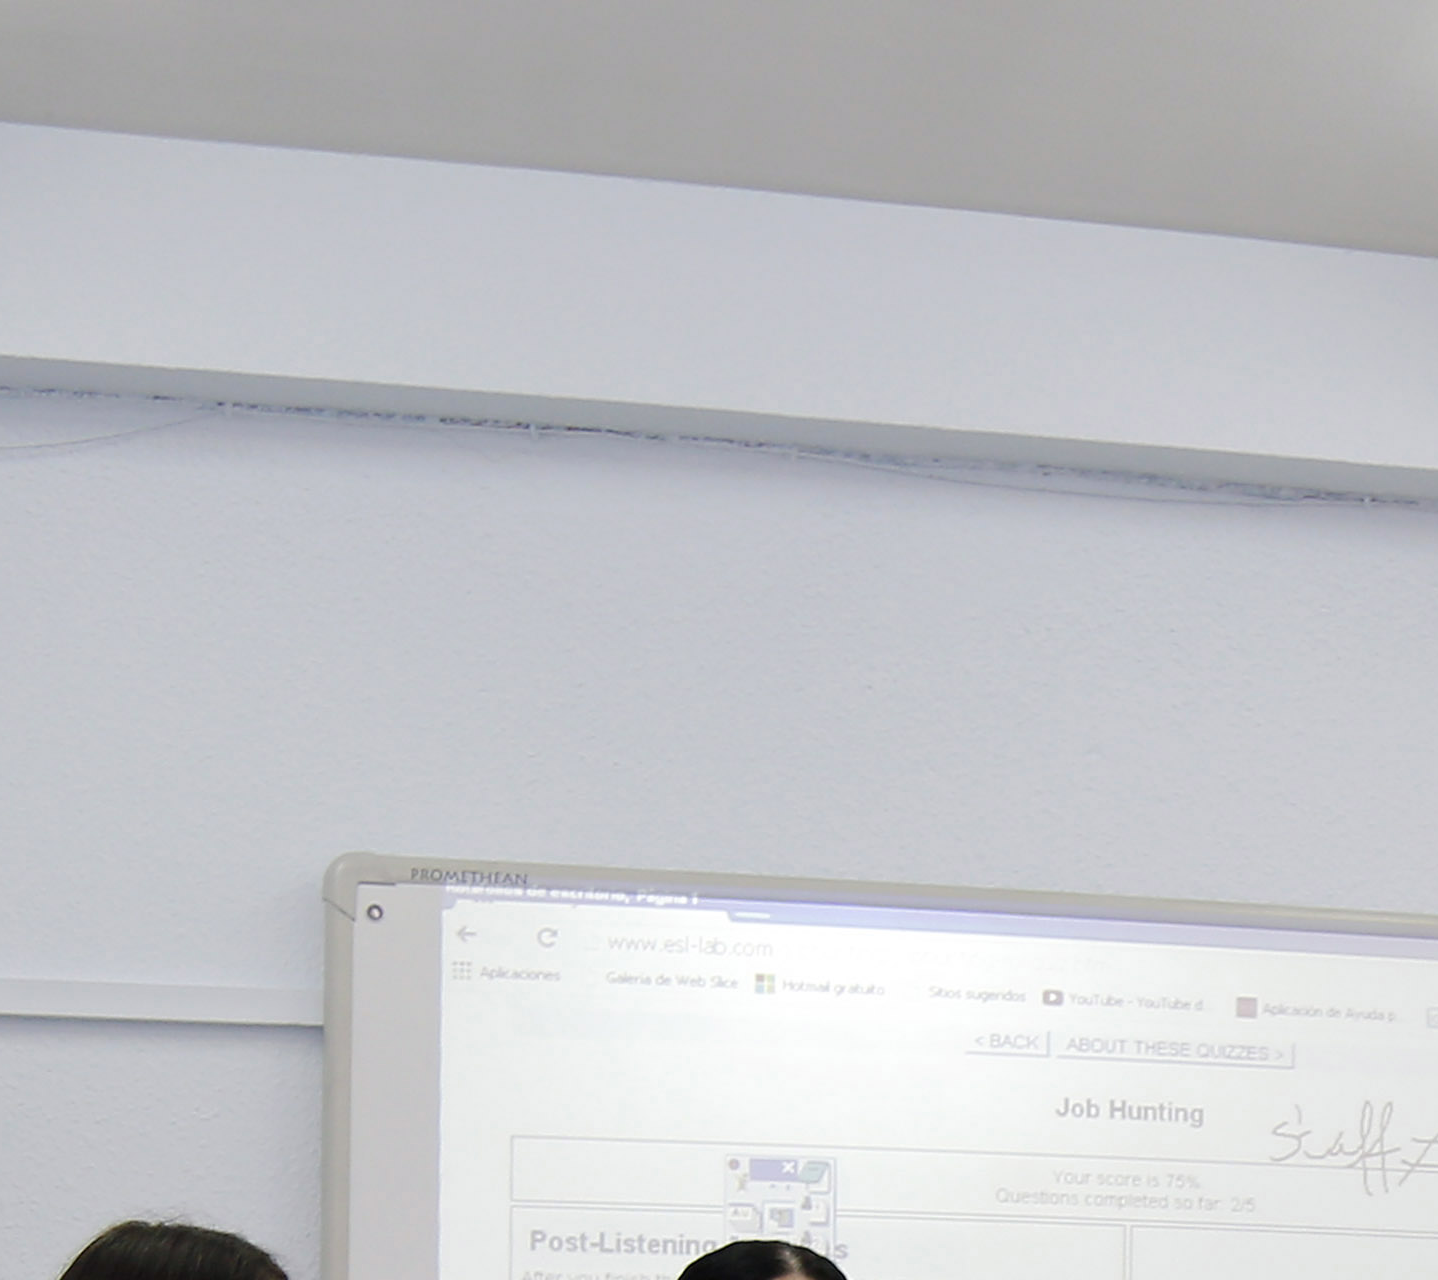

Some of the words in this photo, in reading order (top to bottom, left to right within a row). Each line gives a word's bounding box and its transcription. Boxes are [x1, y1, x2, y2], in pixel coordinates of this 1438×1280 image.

[411, 867, 529, 886] PROMETHEAN
[608, 933, 773, 957] www.esl-lab.com
[480, 966, 561, 983] Aplicaciones
[655, 973, 671, 987] de
[675, 974, 706, 988] Web
[710, 977, 738, 990] Slice
[783, 980, 830, 995] Hotmail
[833, 983, 886, 1000] gratuito
[929, 985, 961, 1001] Sitios
[965, 988, 1027, 1007] sugeridos
[1069, 994, 1123, 1008] YouTube
[1138, 996, 1193, 1010] YouTube
[1263, 1003, 1324, 1020] Aplicación
[1326, 1008, 1342, 1020] de
[1347, 1009, 1384, 1024] Ayuda
[988, 1033, 1040, 1050] BACK
[1067, 1037, 1127, 1053] ABOUT
[1133, 1040, 1191, 1057] THESE
[1196, 1043, 1270, 1061] QUIZZES
[1055, 1098, 1099, 1119] Job
[1108, 1100, 1204, 1128] Hunting
[1053, 1169, 1090, 1184] Your
[1097, 1173, 1142, 1187] score
[1146, 1174, 1160, 1188] is
[1165, 1174, 1200, 1190] 75%
[995, 1187, 1078, 1206] Questions
[1084, 1190, 1169, 1212] completed
[1174, 1197, 1193, 1210] so
[1231, 1198, 1256, 1213] 2/5
